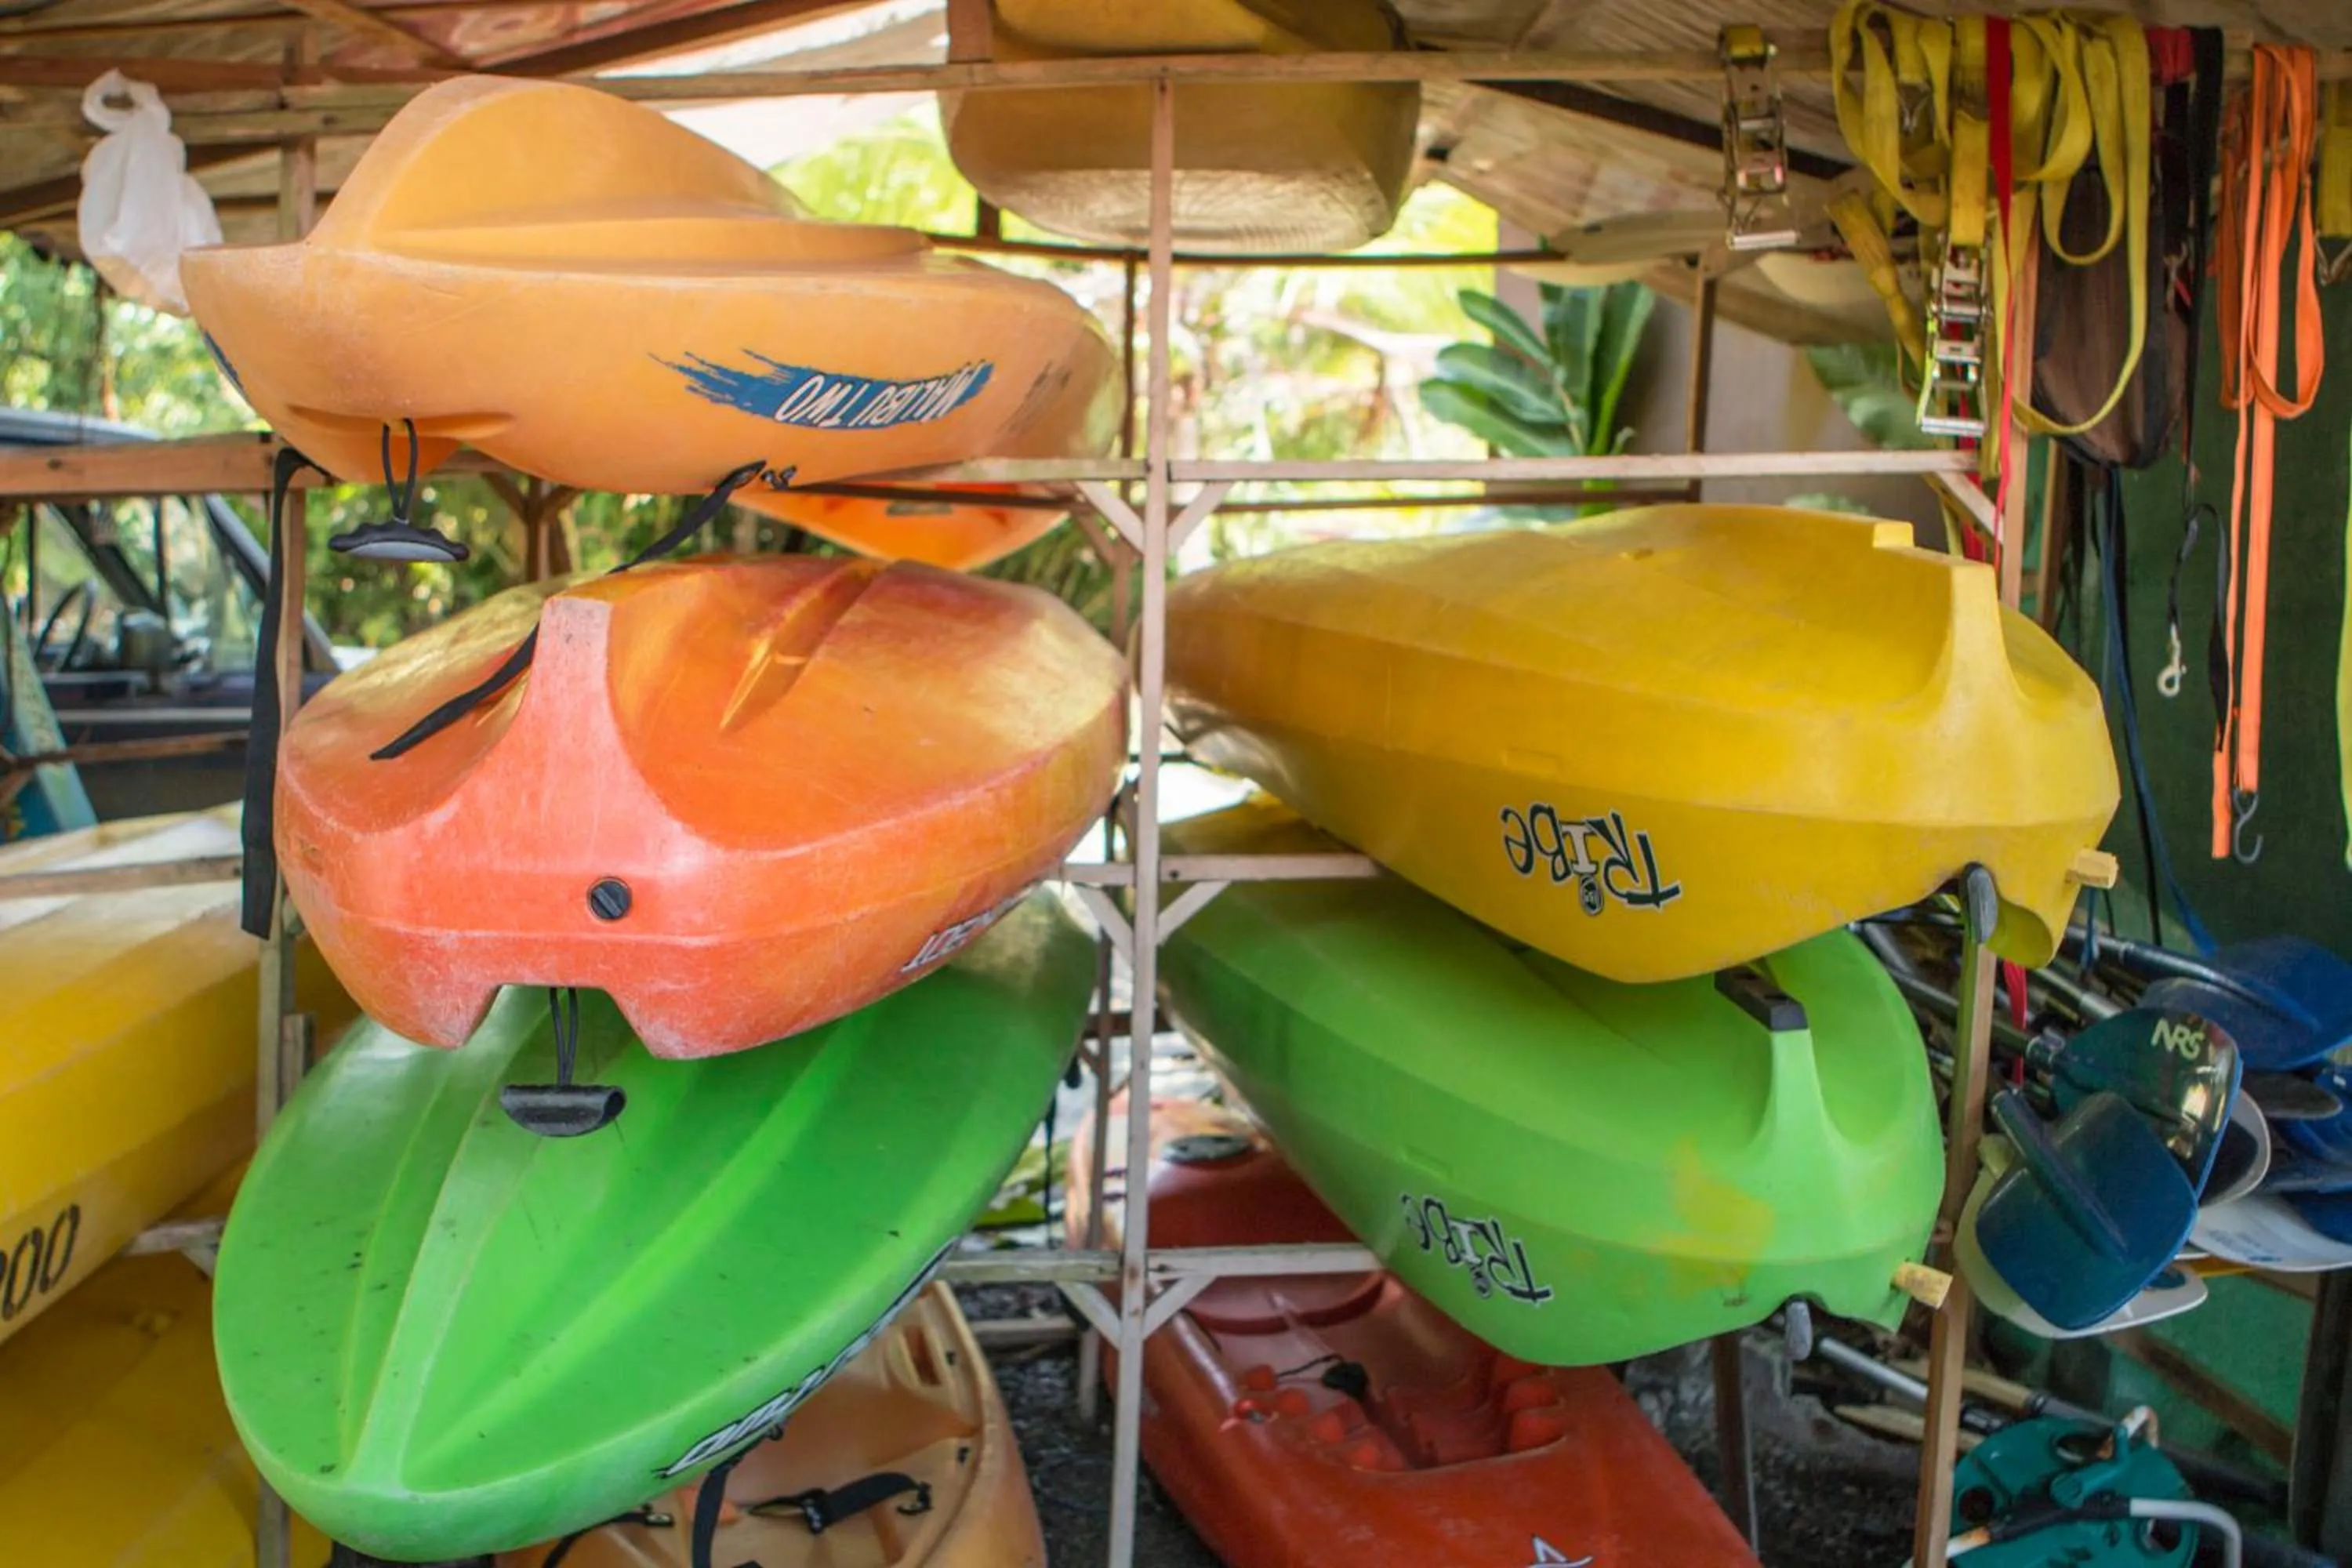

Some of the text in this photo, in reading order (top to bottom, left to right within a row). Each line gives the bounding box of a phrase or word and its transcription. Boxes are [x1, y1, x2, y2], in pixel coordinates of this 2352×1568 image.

[775, 374, 871, 427] TWO
[847, 360, 985, 426] MALIBU
[2150, 1017, 2205, 1061] NRS
[0, 1204, 81, 1321] 00
